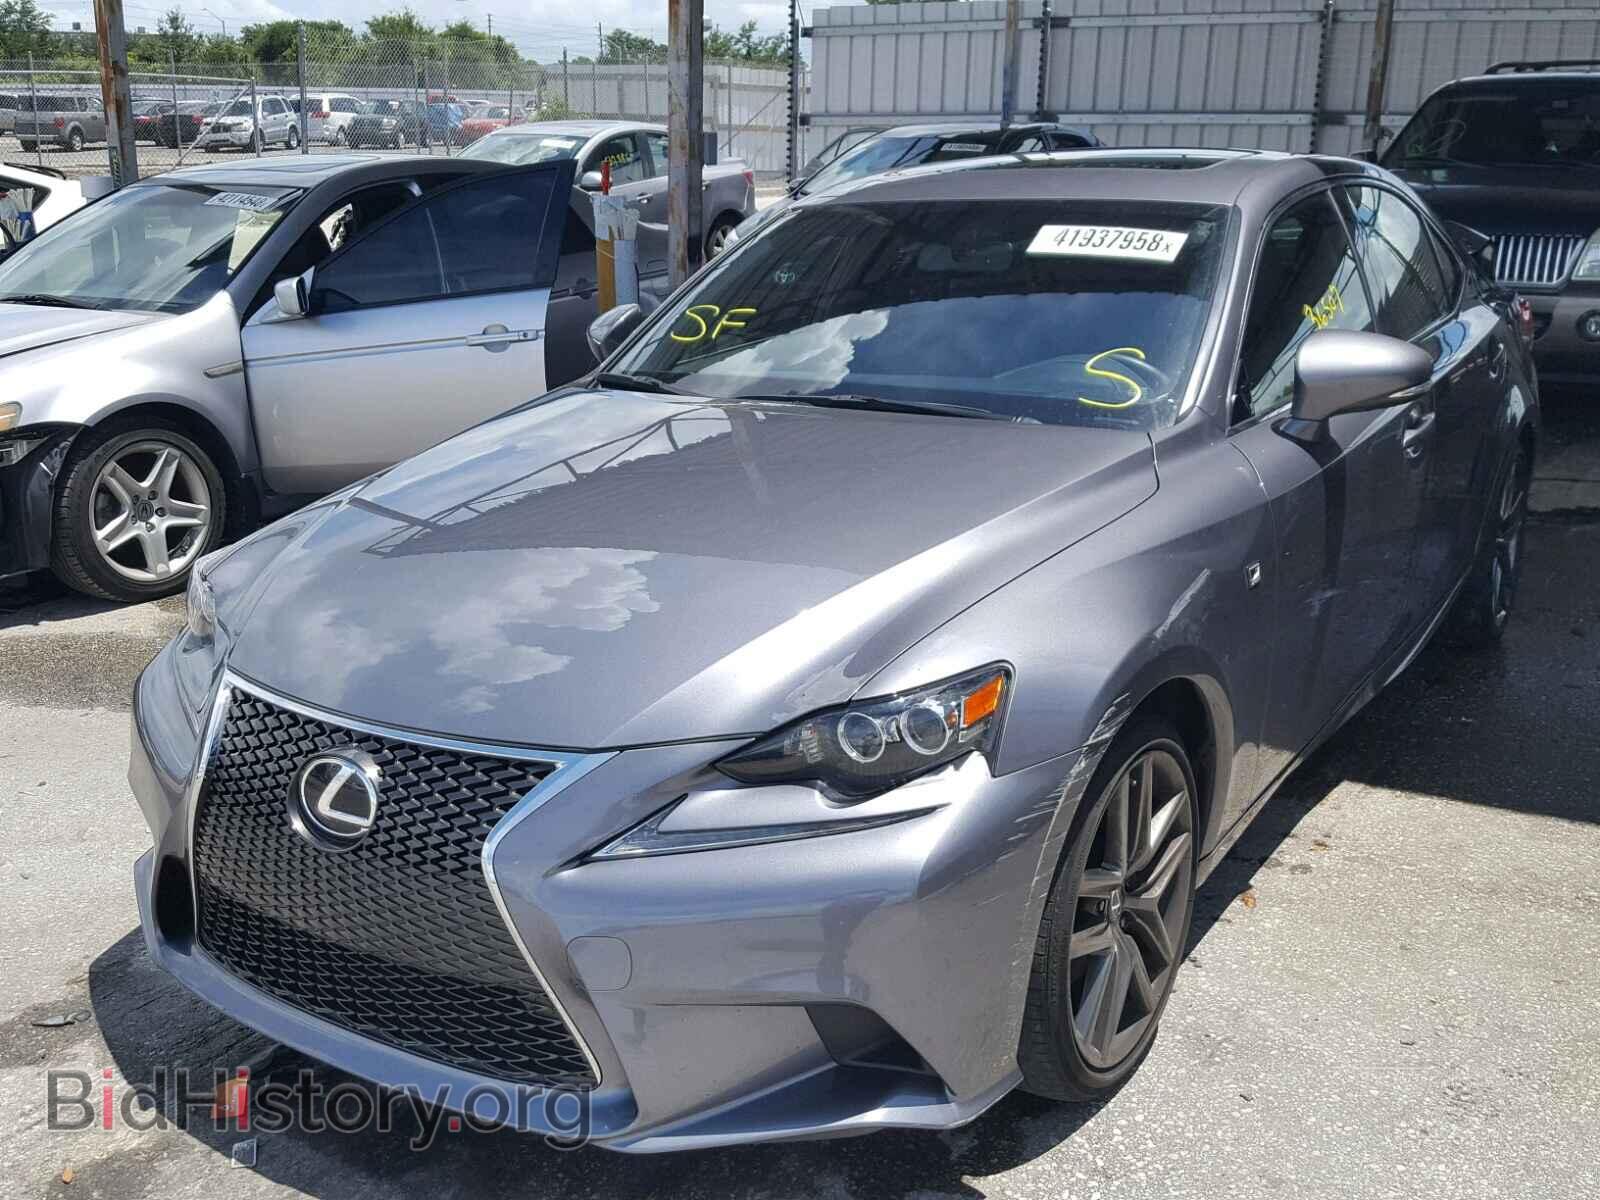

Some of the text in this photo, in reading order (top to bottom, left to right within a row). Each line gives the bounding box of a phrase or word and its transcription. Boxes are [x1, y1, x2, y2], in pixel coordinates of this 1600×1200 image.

[1054, 228, 1164, 252] 41937958
[671, 304, 757, 342] SF
[1078, 346, 1146, 408] S
